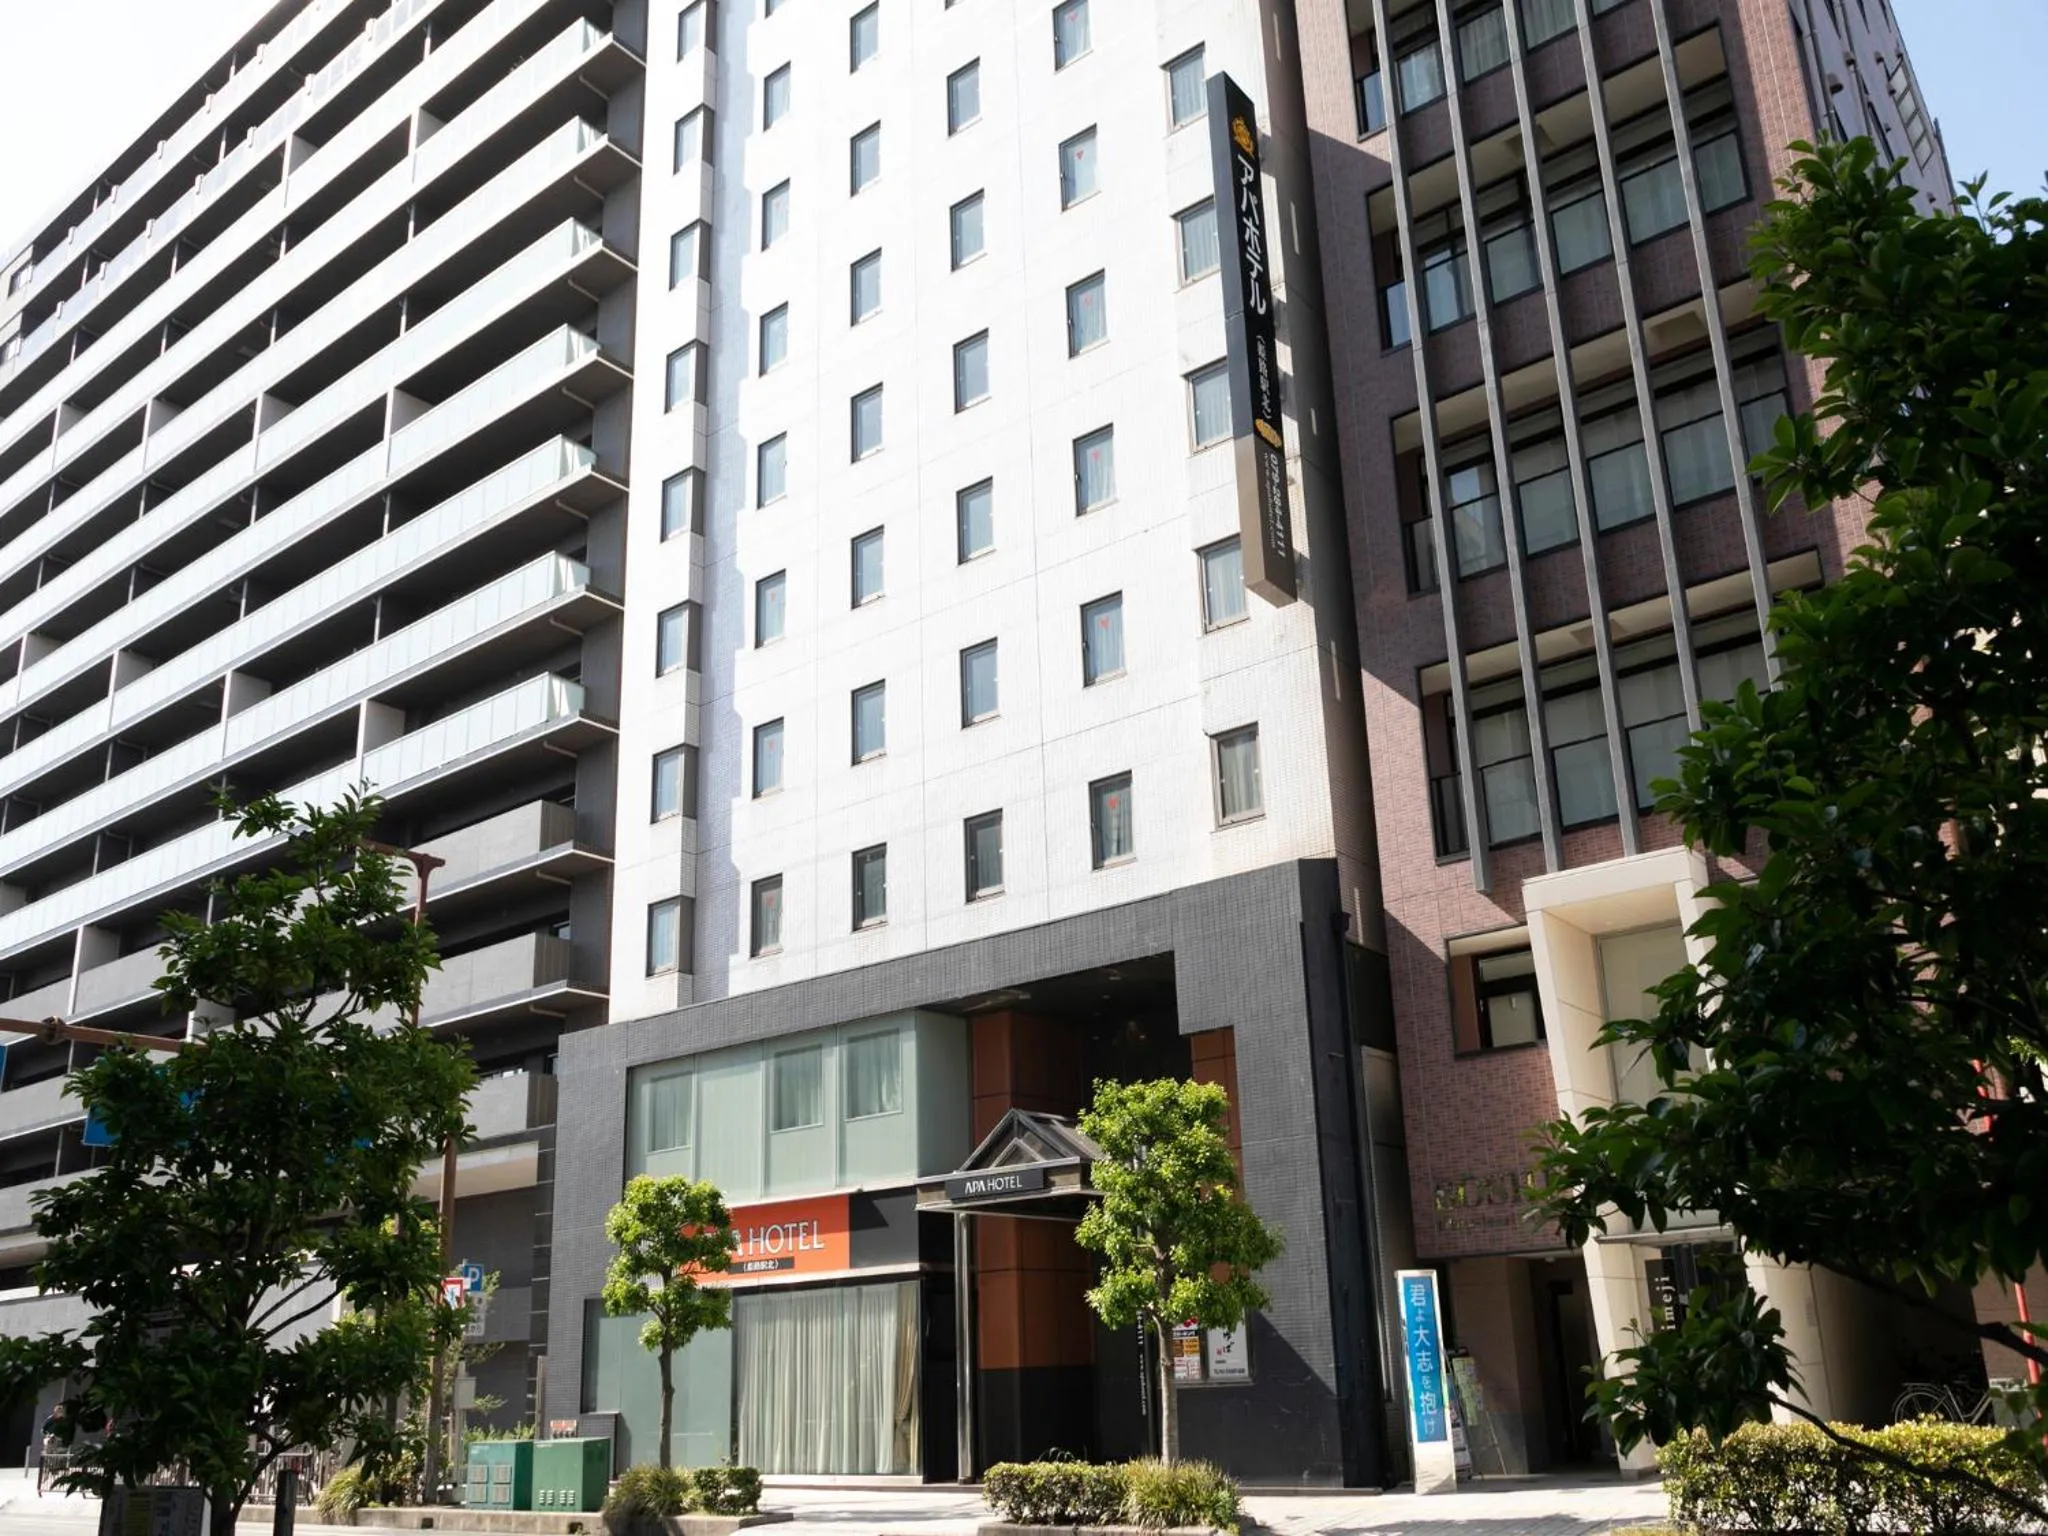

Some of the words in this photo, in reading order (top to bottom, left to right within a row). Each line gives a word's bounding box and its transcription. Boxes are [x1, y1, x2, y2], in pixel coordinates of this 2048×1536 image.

[1238, 154, 1267, 315] アパホテル
[964, 1180, 986, 1194] APA
[987, 1175, 1023, 1191] HOTEL
[748, 1220, 825, 1256] HOTEL
[468, 1267, 481, 1283] P
[1654, 1276, 1676, 1330] imeji
[1410, 1284, 1437, 1435] 君よ大志を抱け
